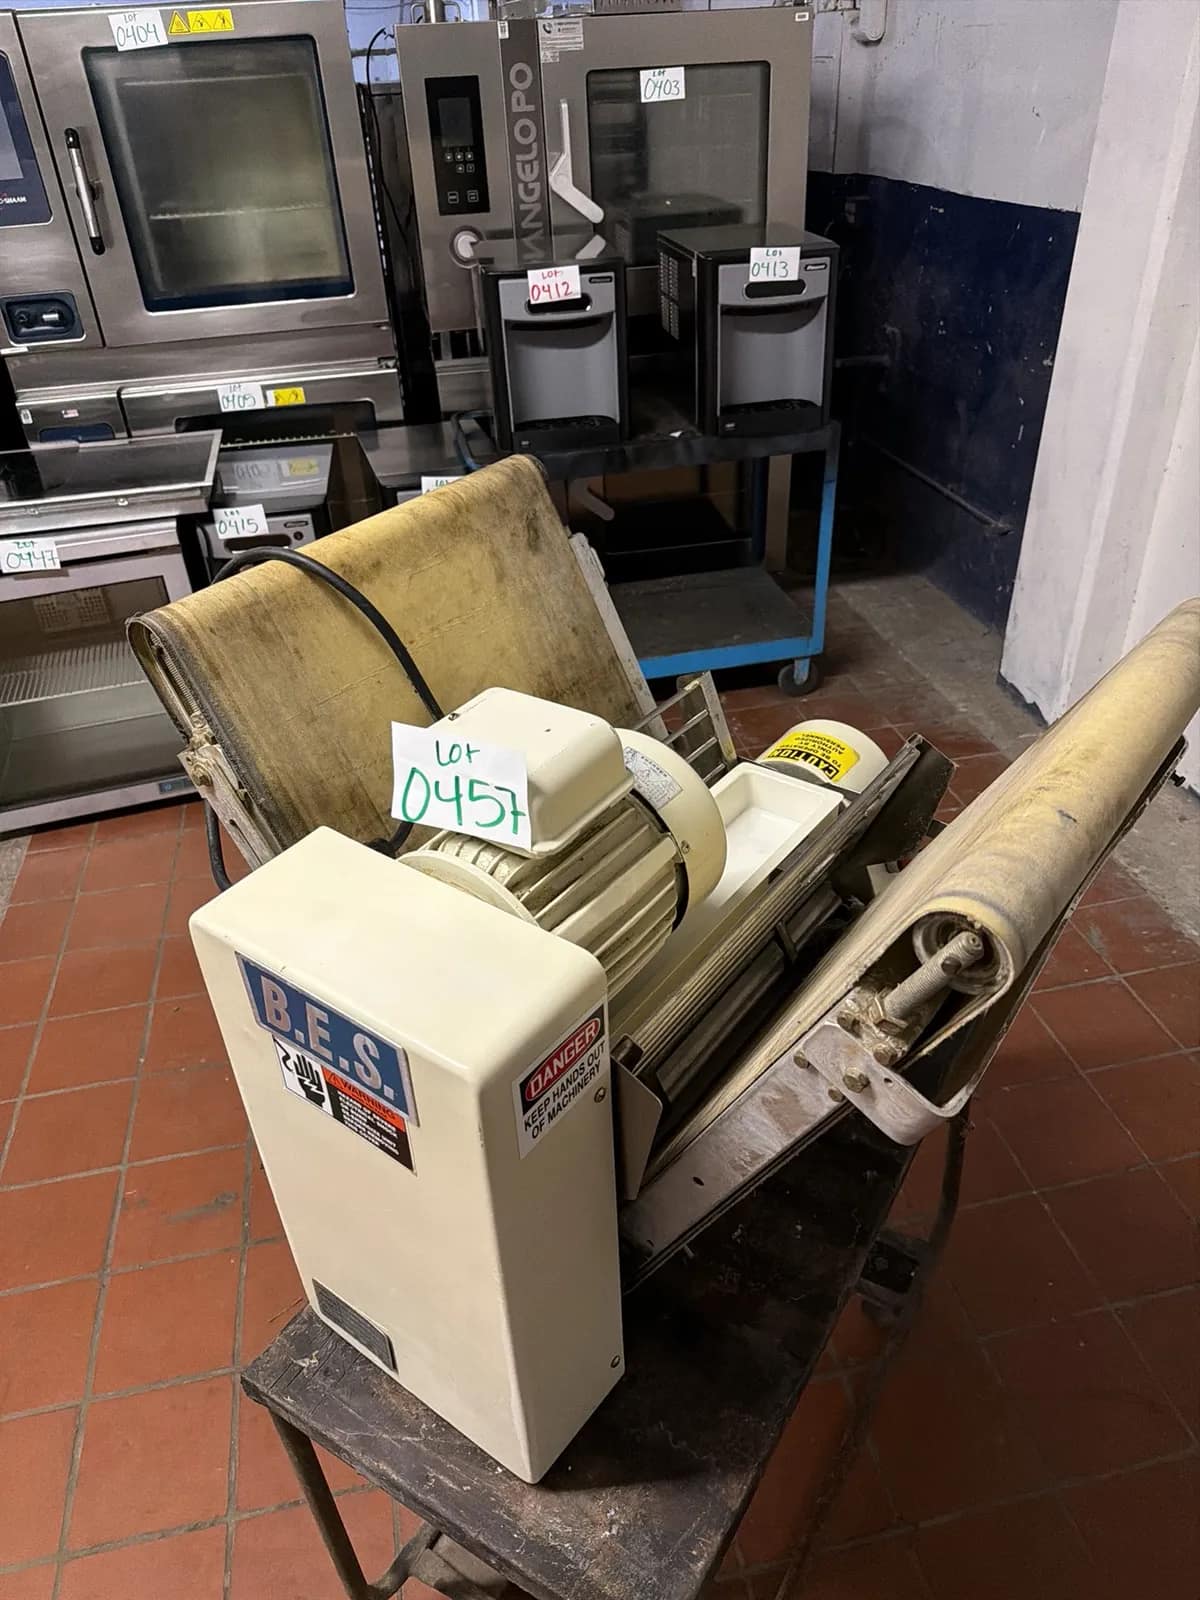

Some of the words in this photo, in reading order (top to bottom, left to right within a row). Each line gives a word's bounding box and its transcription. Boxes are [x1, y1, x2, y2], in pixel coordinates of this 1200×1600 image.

[117, 22, 160, 47] 0404
[509, 62, 535, 113] PO
[644, 78, 680, 99] 0403
[751, 261, 789, 278] 0413
[531, 281, 573, 301] 0412
[218, 518, 259, 535] 0415
[6, 550, 58, 569] 0447
[401, 766, 527, 836] 0457
[260, 974, 395, 1101] B.E.S.
[529, 1021, 597, 1098] DANGER
[524, 1096, 551, 1132] KEEP
[552, 1062, 585, 1103] HANDS
[587, 1040, 606, 1067] OUT
[531, 1117, 547, 1139] OF
[547, 1059, 602, 1124] MACHINERY
